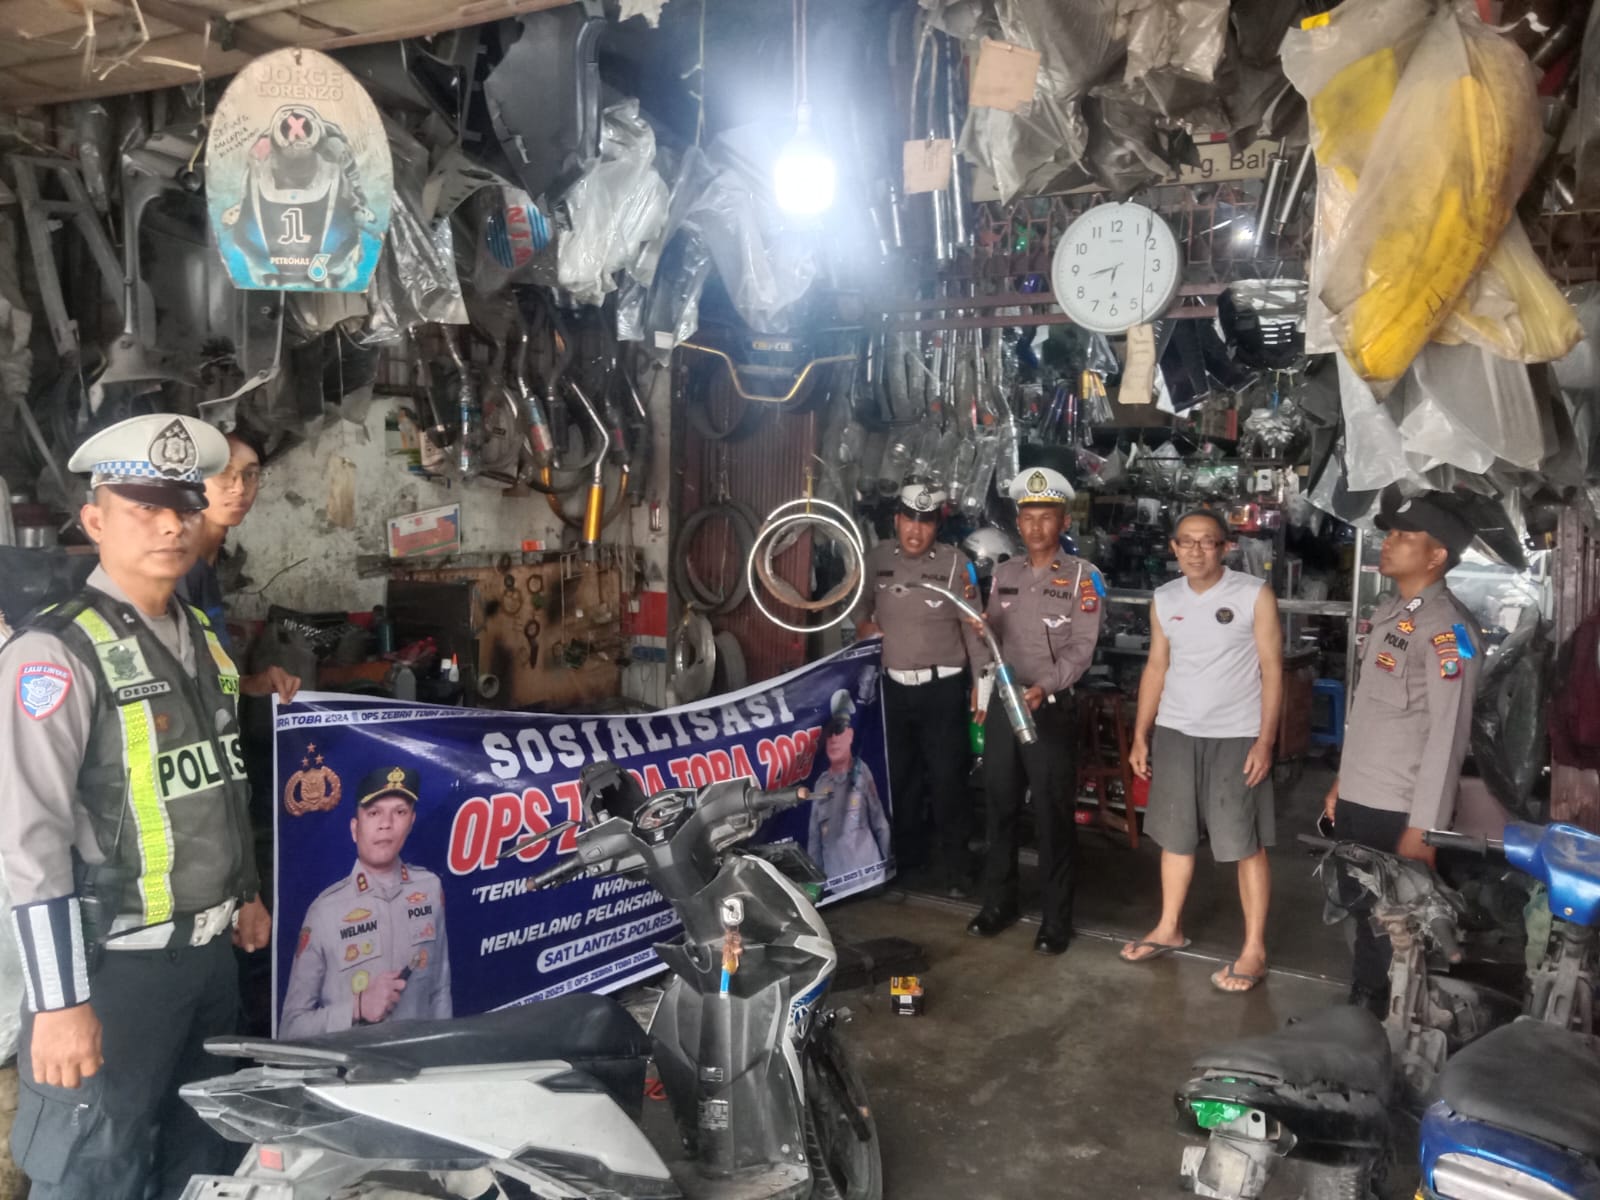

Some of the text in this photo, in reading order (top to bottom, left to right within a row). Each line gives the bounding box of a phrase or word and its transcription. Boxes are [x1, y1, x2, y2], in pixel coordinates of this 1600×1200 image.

[259, 64, 343, 87] JORGE
[257, 85, 344, 100] LORENZO
[1092, 227, 1102, 239] 11
[1111, 220, 1123, 233] 12
[1135, 223, 1140, 236] 1
[1076, 243, 1088, 256] 10
[1147, 238, 1157, 250] 2
[270, 257, 310, 265] PETRONAS
[1151, 259, 1161, 272] 3
[1071, 264, 1080, 277] 9
[1076, 286, 1085, 300] 8
[1144, 282, 1154, 294] 4
[1090, 300, 1099, 313] 7
[1108, 304, 1119, 317] 6
[1128, 298, 1138, 311] 5
[1043, 588, 1073, 600] POLRI
[1384, 633, 1408, 651] POLRI
[123, 683, 167, 697] DEDDY
[291, 715, 322, 725] TOBA
[361, 711, 379, 721] OPS
[381, 710, 413, 720] ZEBRA
[482, 687, 795, 780] SOSIALISASI
[448, 787, 552, 876] OPS
[408, 905, 433, 919] POLRI
[340, 920, 378, 940] WELMAN
[628, 911, 674, 938] POLRES
[480, 912, 582, 957] MENJELANG
[574, 974, 590, 988] OPS
[633, 949, 651, 963] 2025
